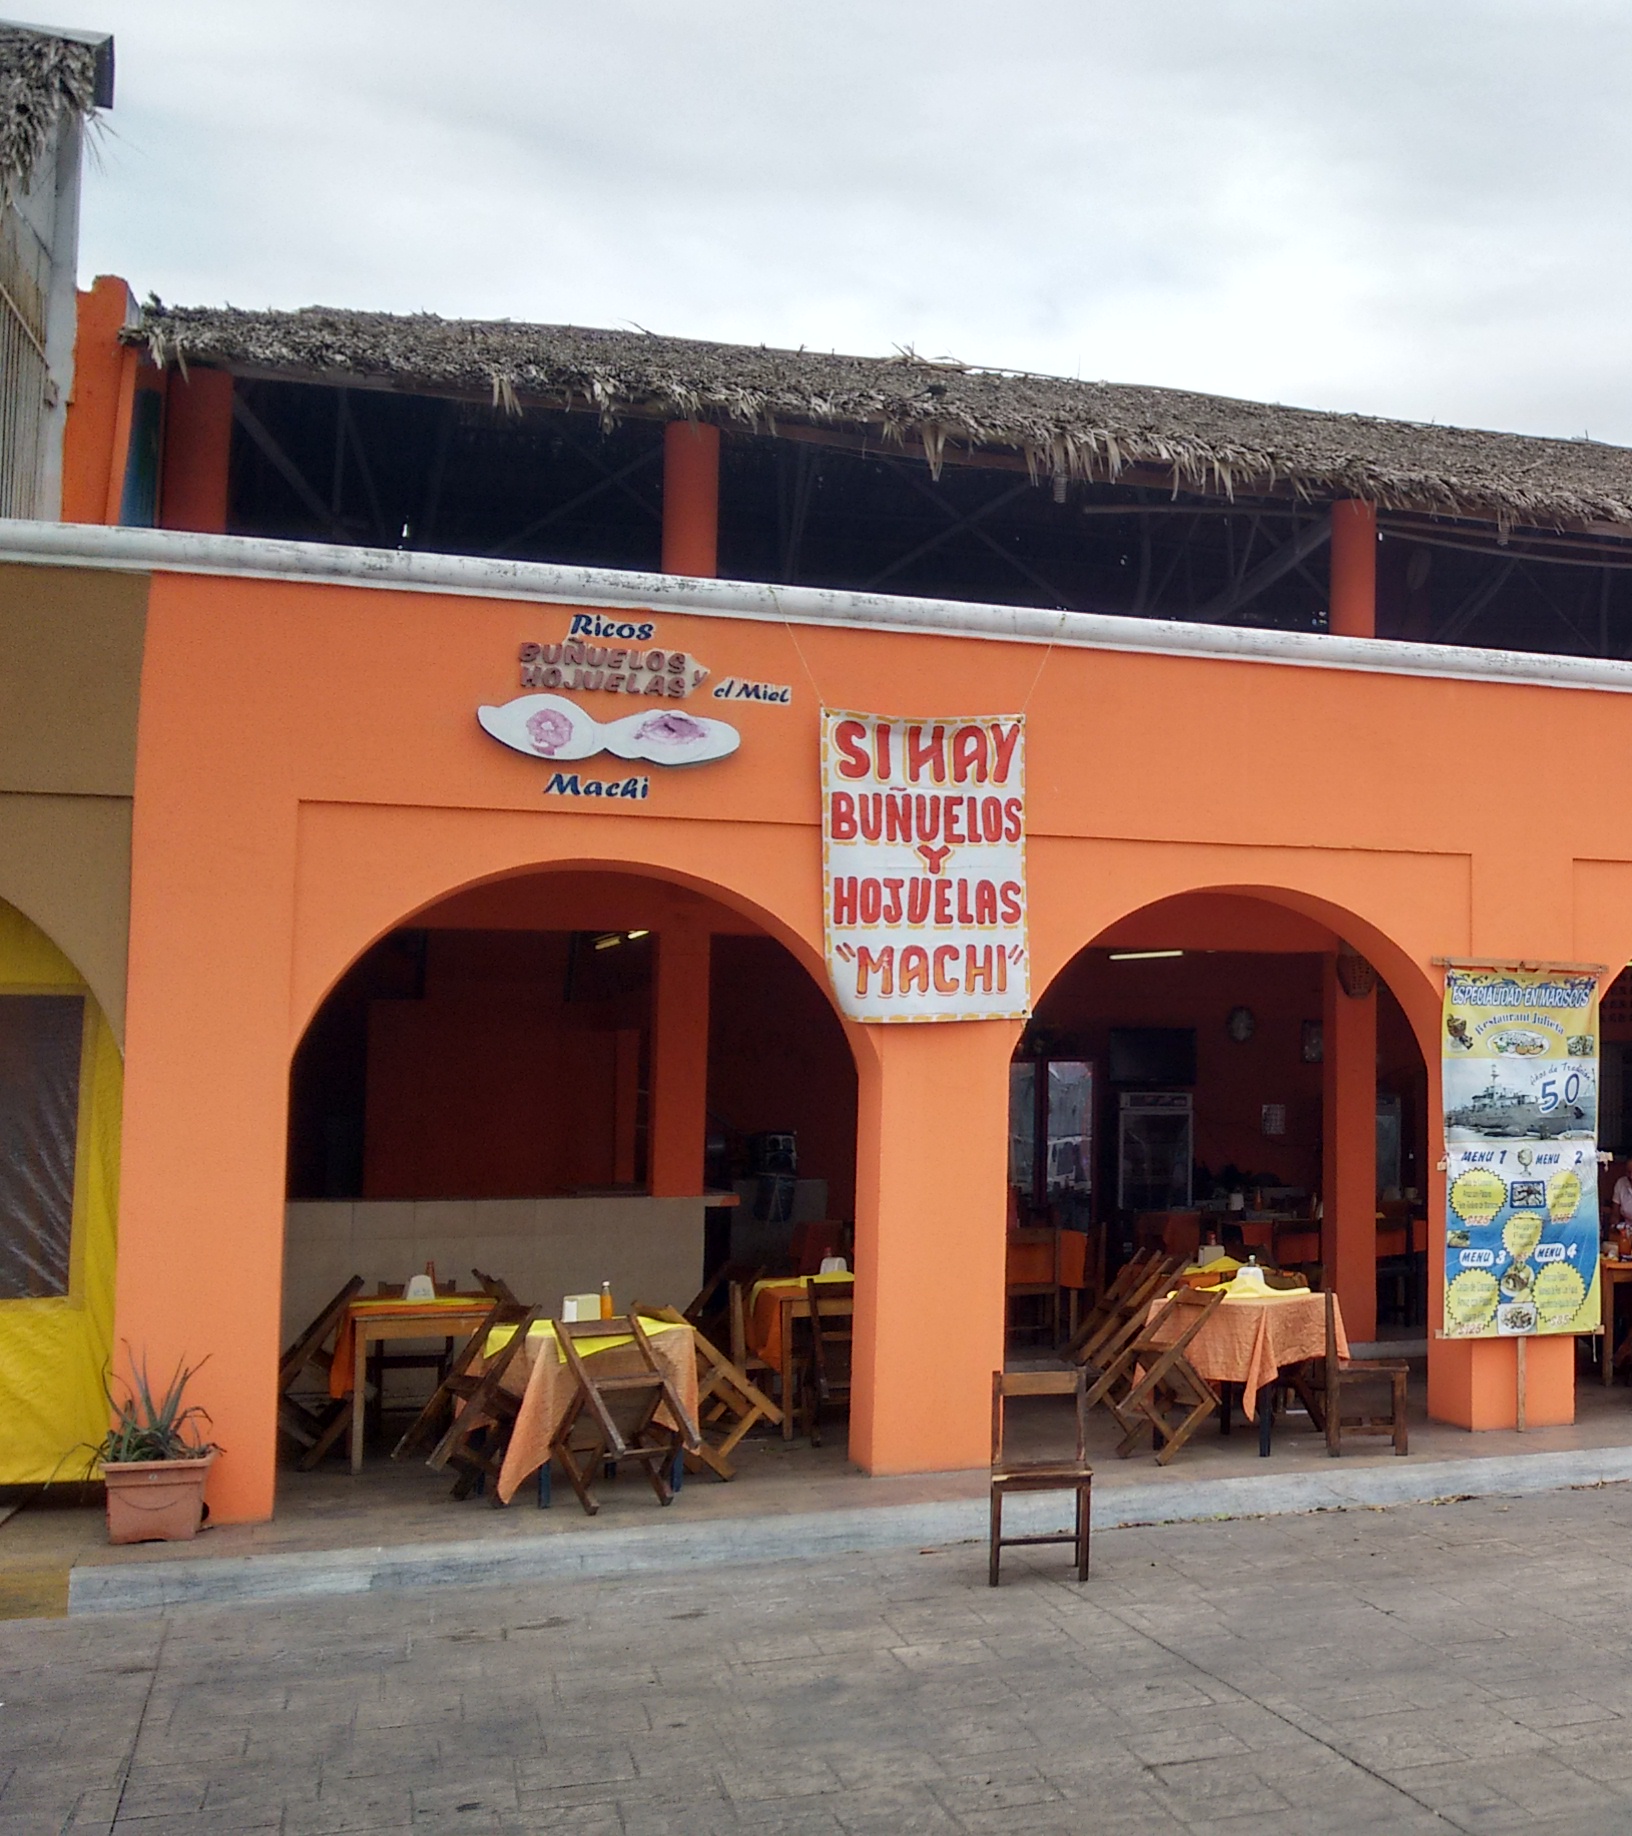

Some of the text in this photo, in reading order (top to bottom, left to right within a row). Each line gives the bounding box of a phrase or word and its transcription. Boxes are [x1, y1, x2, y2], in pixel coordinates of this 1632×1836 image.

[570, 614, 654, 640] Ricos
[519, 637, 686, 674] BUÑUELOS
[520, 664, 686, 699] HOJUELAS
[735, 683, 789, 703] Miel
[834, 720, 1020, 783] SI HAY
[544, 773, 649, 799] Machi
[831, 786, 1022, 844] BUÑUELOS
[917, 844, 951, 875] Y
[833, 876, 1022, 925] HOJUELAS
[1452, 986, 1589, 1008] ESPECIALIDAD EN MARISCOS
[1475, 1013, 1564, 1035] Restaurant Julieta
[1461, 1150, 1507, 1164] MENU 1
[1535, 1151, 1583, 1165] MENU 2
[1461, 1251, 1491, 1263] MENU
[1496, 1250, 1506, 1265] 3
[1537, 1246, 1562, 1258] MENU
[1567, 1243, 1577, 1259] 4
